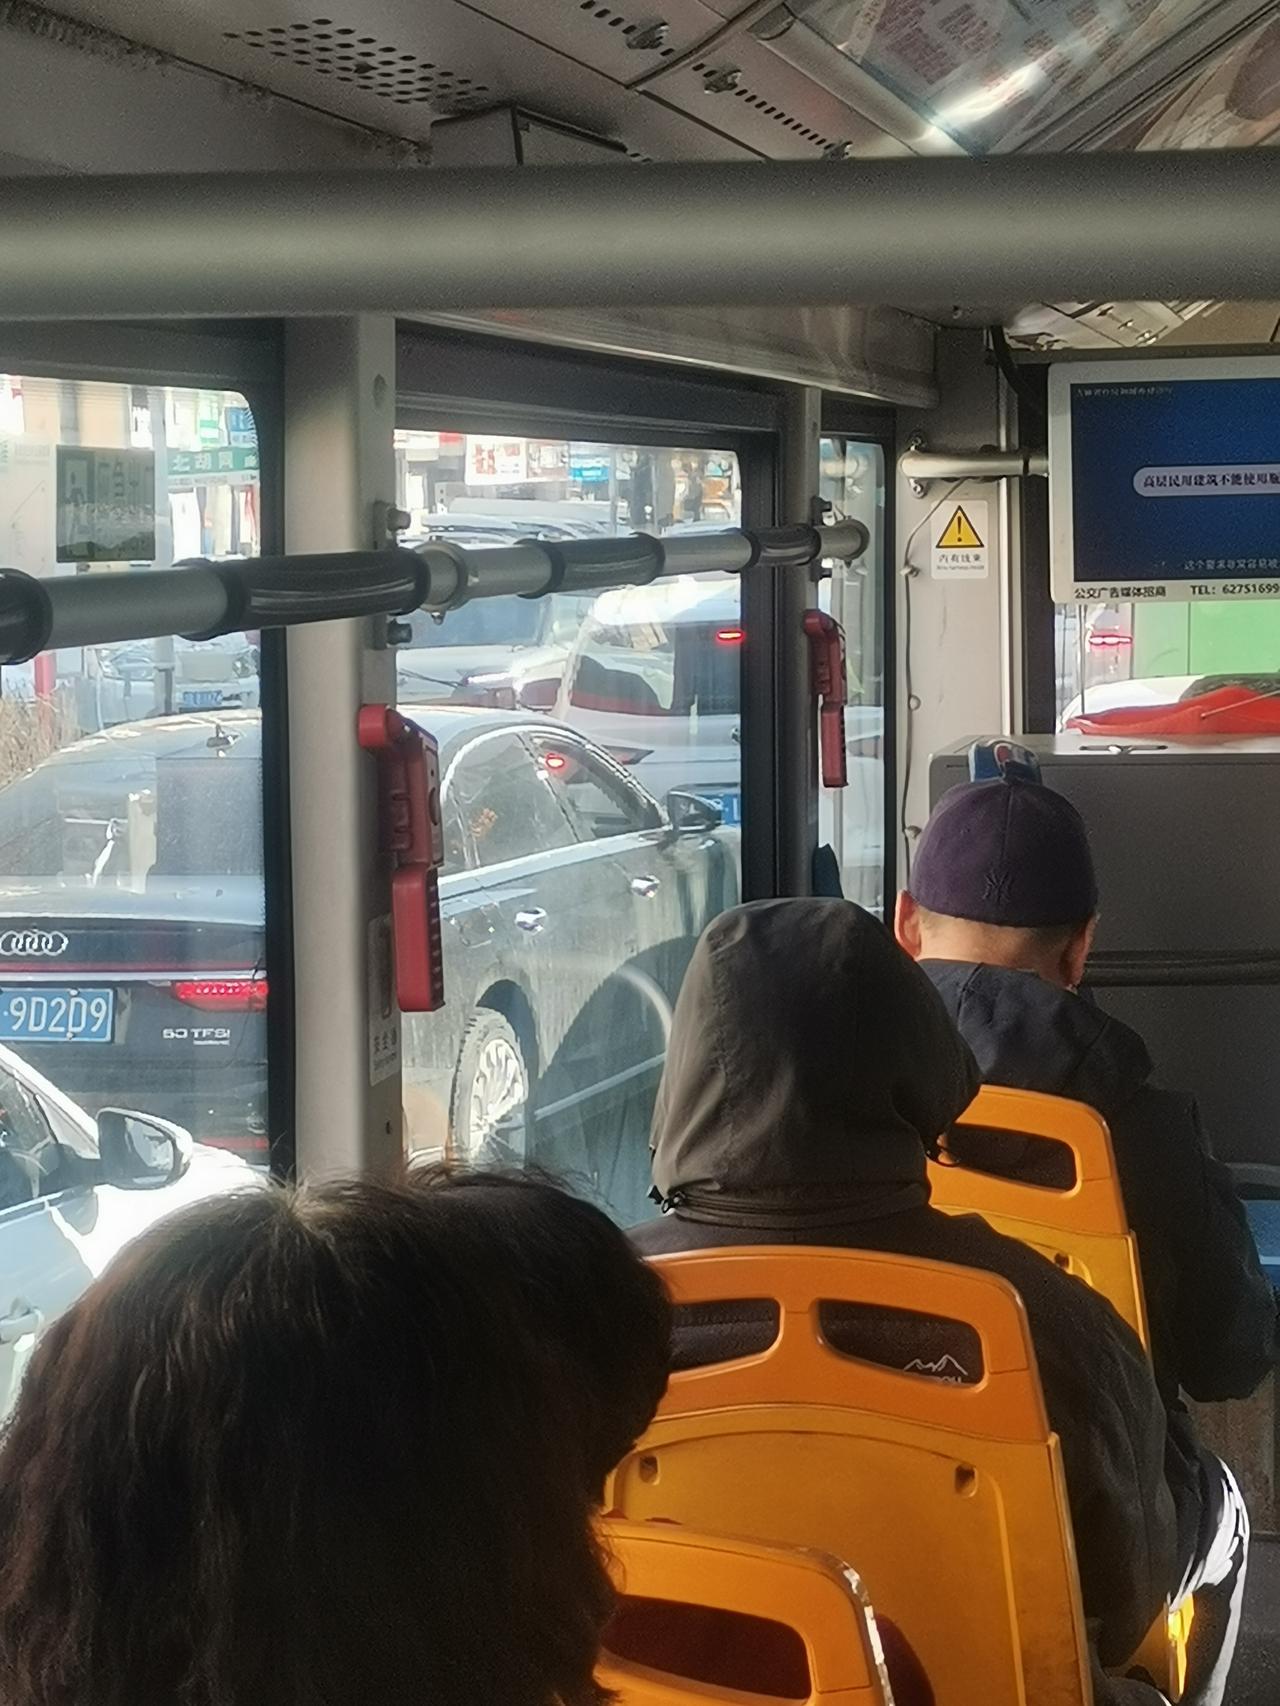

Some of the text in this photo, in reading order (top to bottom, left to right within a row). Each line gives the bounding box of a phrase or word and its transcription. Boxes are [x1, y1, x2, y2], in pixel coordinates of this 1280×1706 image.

[1075, 582, 1280, 598] 公交广告媒体招商 TEL: 62751699
[190, 1028, 231, 1039] TFSI
